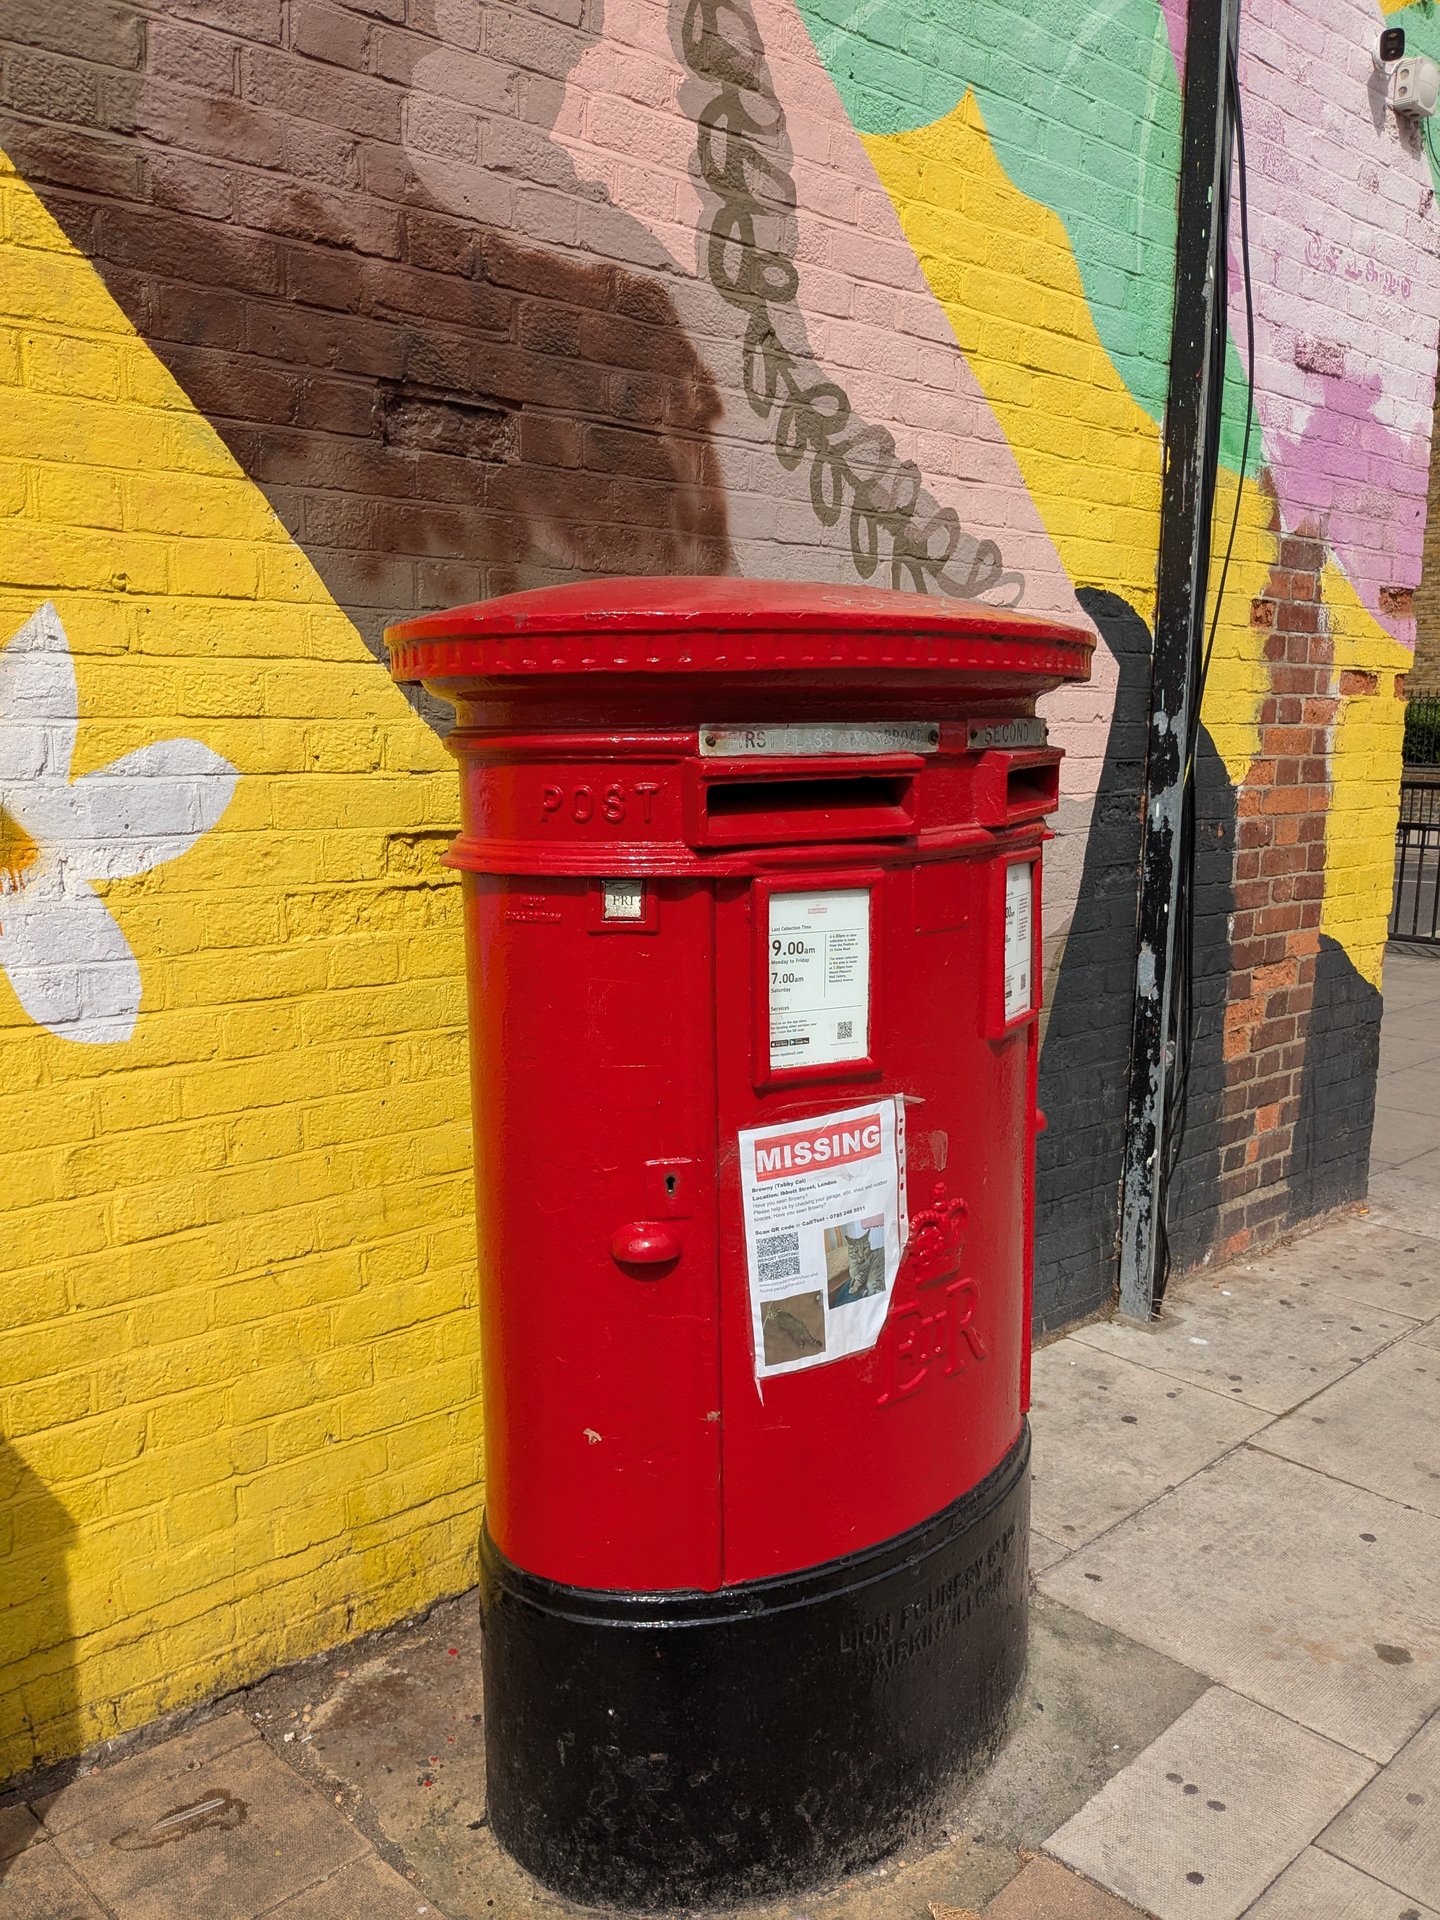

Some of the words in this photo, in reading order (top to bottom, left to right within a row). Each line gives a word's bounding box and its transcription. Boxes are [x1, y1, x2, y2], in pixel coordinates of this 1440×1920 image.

[984, 722, 1030, 743] SECOND
[540, 783, 660, 823] POST
[612, 895, 634, 906] FRI
[756, 1125, 881, 1173] MISSING
[751, 1185, 773, 1193] Browny
[774, 1180, 794, 1190] (Tabby
[752, 1192, 779, 1201] Location:
[798, 1184, 816, 1193] Street,
[818, 1180, 837, 1188] London
[788, 1193, 808, 1203] Browny?
[795, 1198, 815, 1209] checking
[815, 1196, 825, 1204] your
[808, 1202, 826, 1212] Browny?
